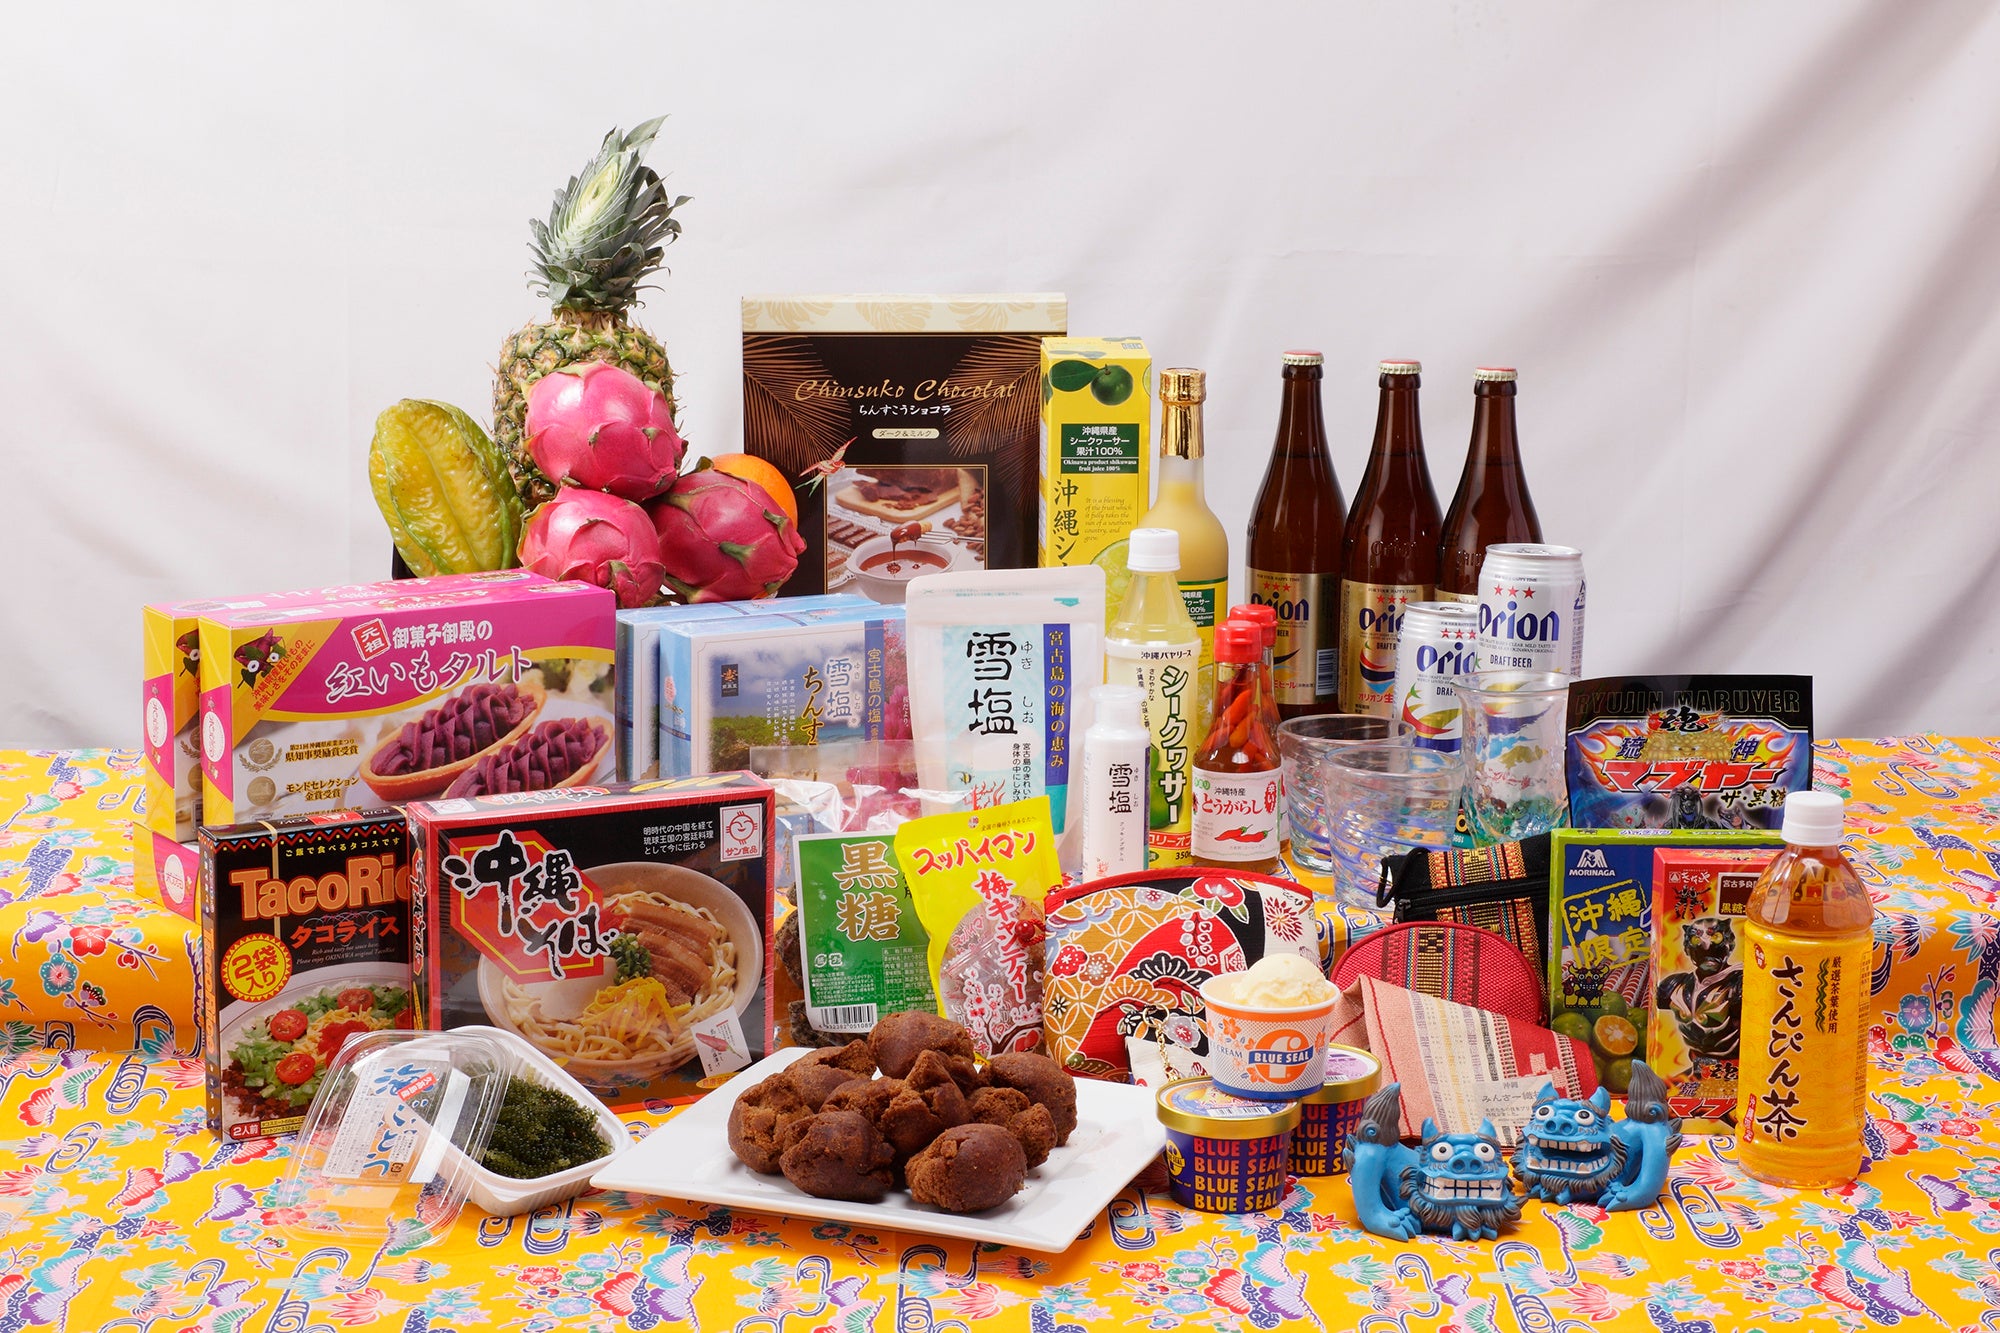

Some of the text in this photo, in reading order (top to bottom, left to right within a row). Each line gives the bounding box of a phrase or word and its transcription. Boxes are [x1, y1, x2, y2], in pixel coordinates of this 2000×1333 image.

[794, 378, 1017, 401] Chinsuko Chocolat
[858, 403, 952, 416] ちんすこうショコラ
[1081, 426, 1118, 436] 沖縄県産
[1076, 446, 1123, 456] 果汁100%
[1052, 478, 1080, 568] 沖縄シ
[1479, 600, 1560, 641] Orion
[361, 626, 386, 653] 元祖
[392, 619, 493, 649] 御菓子御殿の
[1020, 640, 1034, 671] ゆき
[1141, 649, 1192, 660] 沖縄バヤリース
[1490, 654, 1532, 668] DRAFT BEER
[253, 639, 316, 712] 美味しさをそのままに
[325, 645, 532, 703] 紅いもタルト
[967, 631, 1018, 735] 雪塩
[826, 657, 853, 718] 雪塩
[1048, 629, 1065, 768] 宮古島の海の恵み
[801, 666, 825, 746] ちんす
[1022, 695, 1035, 724] しお
[1575, 689, 1800, 716] RYUJIN MABUYER
[1160, 665, 1189, 824] シークワサー
[1616, 736, 1760, 762] 琉 神
[286, 777, 360, 793] モンドセレクション
[1109, 763, 1133, 813] 雪塩
[1601, 759, 1786, 794] マブヤー
[305, 788, 341, 801] 金賞受賞
[1201, 792, 1263, 815] とうがらし
[1214, 787, 1247, 797] 沖縄特産
[643, 820, 714, 836] 明時代の中国を経て
[643, 830, 714, 846] 琉球王国の宮廷料理
[285, 837, 400, 857] ご飯で食べるタコスです
[644, 840, 706, 855] として今に伝わる
[725, 845, 758, 856] サン食品
[911, 830, 1036, 878] スッパイマン
[1568, 869, 1616, 877] MORINAGA
[832, 840, 903, 942] 黒糖
[1569, 888, 1643, 932] 沖縄
[290, 915, 400, 949] タコライス
[973, 871, 1026, 1001] 梅キャンディー
[325, 952, 354, 961] OKINAWA
[1579, 925, 1651, 969] 限定
[1827, 955, 1842, 1034] 厳選茶葉使用
[1216, 1045, 1243, 1058] CREAM
[1254, 1052, 1309, 1063] BLUE SEAL
[1756, 955, 1808, 1142] さんぴん茶
[233, 1124, 259, 1137] 2人前
[1193, 1135, 1284, 1157] BLUE SEAL
[1194, 1154, 1282, 1176] BLUE SEAL
[1194, 1172, 1280, 1194] BLUE SEAL
[1194, 1190, 1278, 1212] BLUE SEAL
